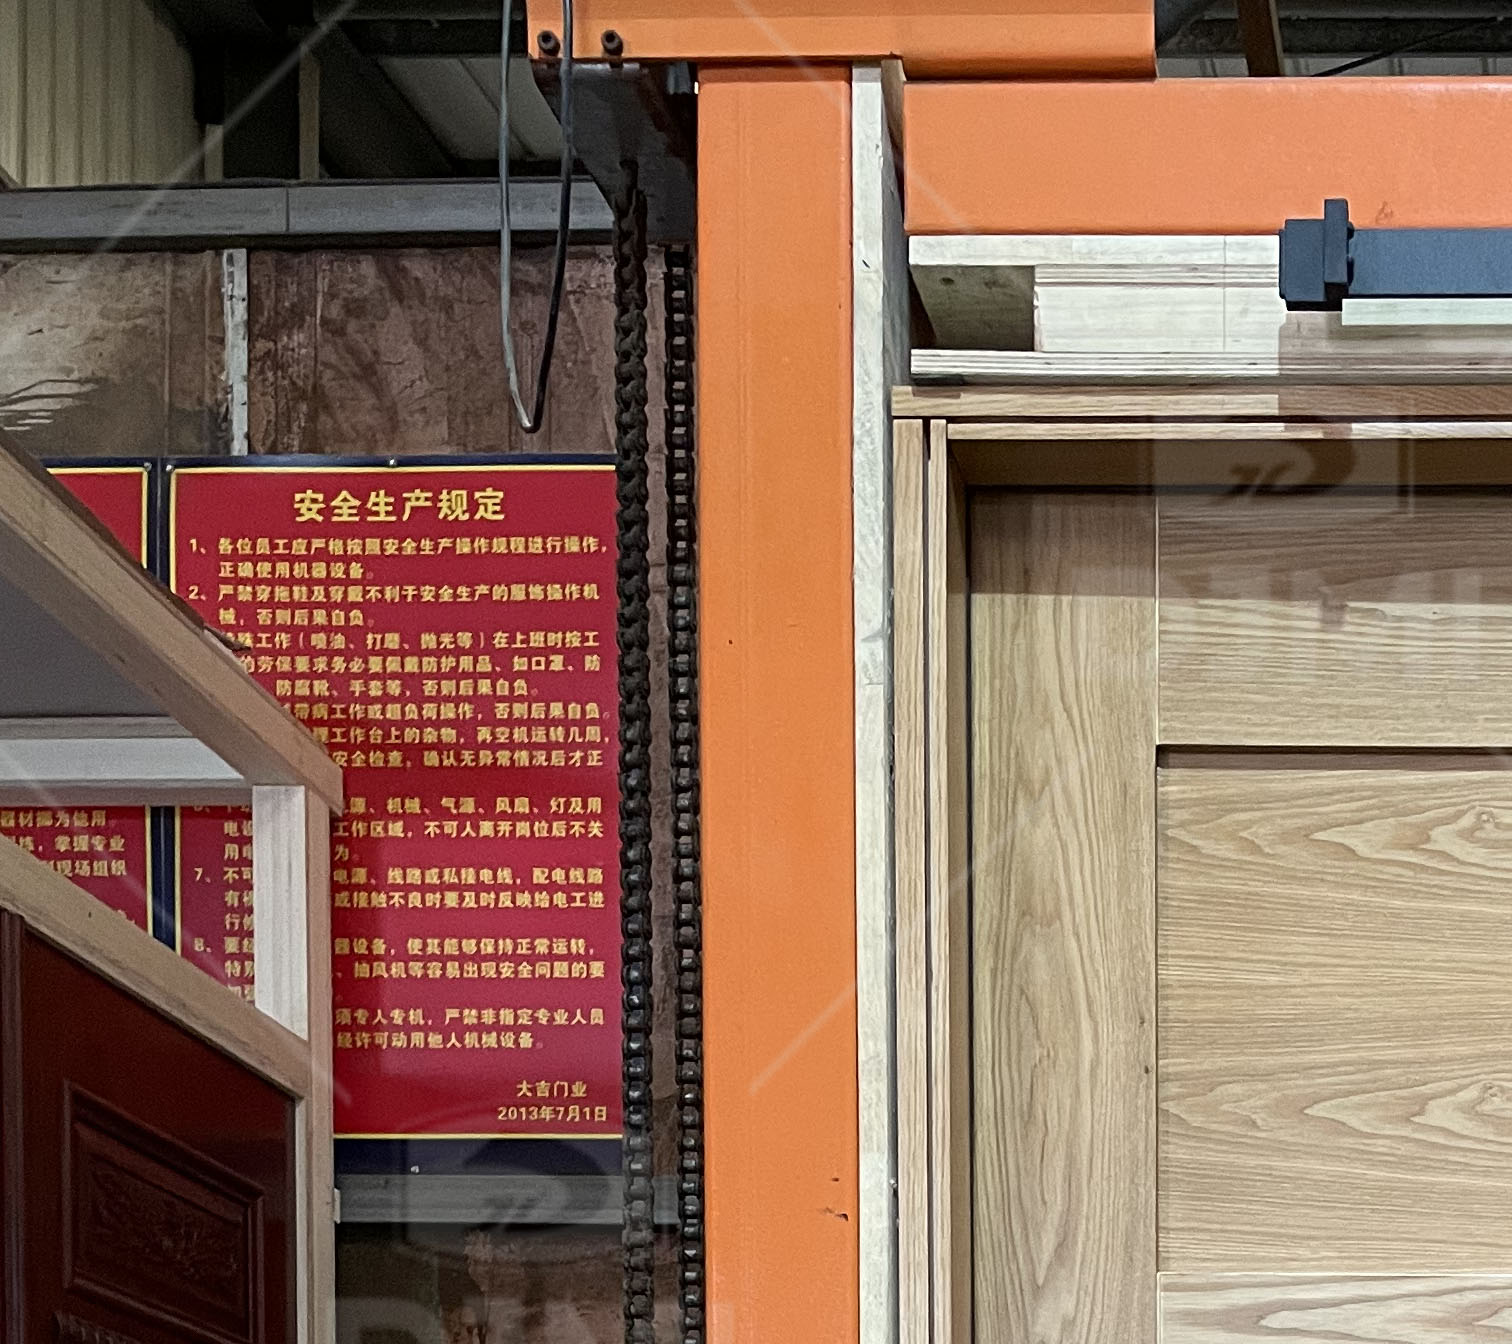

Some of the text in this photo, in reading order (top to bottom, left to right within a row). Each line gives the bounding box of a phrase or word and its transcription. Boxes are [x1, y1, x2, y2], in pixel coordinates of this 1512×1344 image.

[294, 488, 504, 522] 安全生产规定
[517, 1080, 586, 1097] 大吉门业
[498, 1105, 606, 1121] 2013年7月1日
